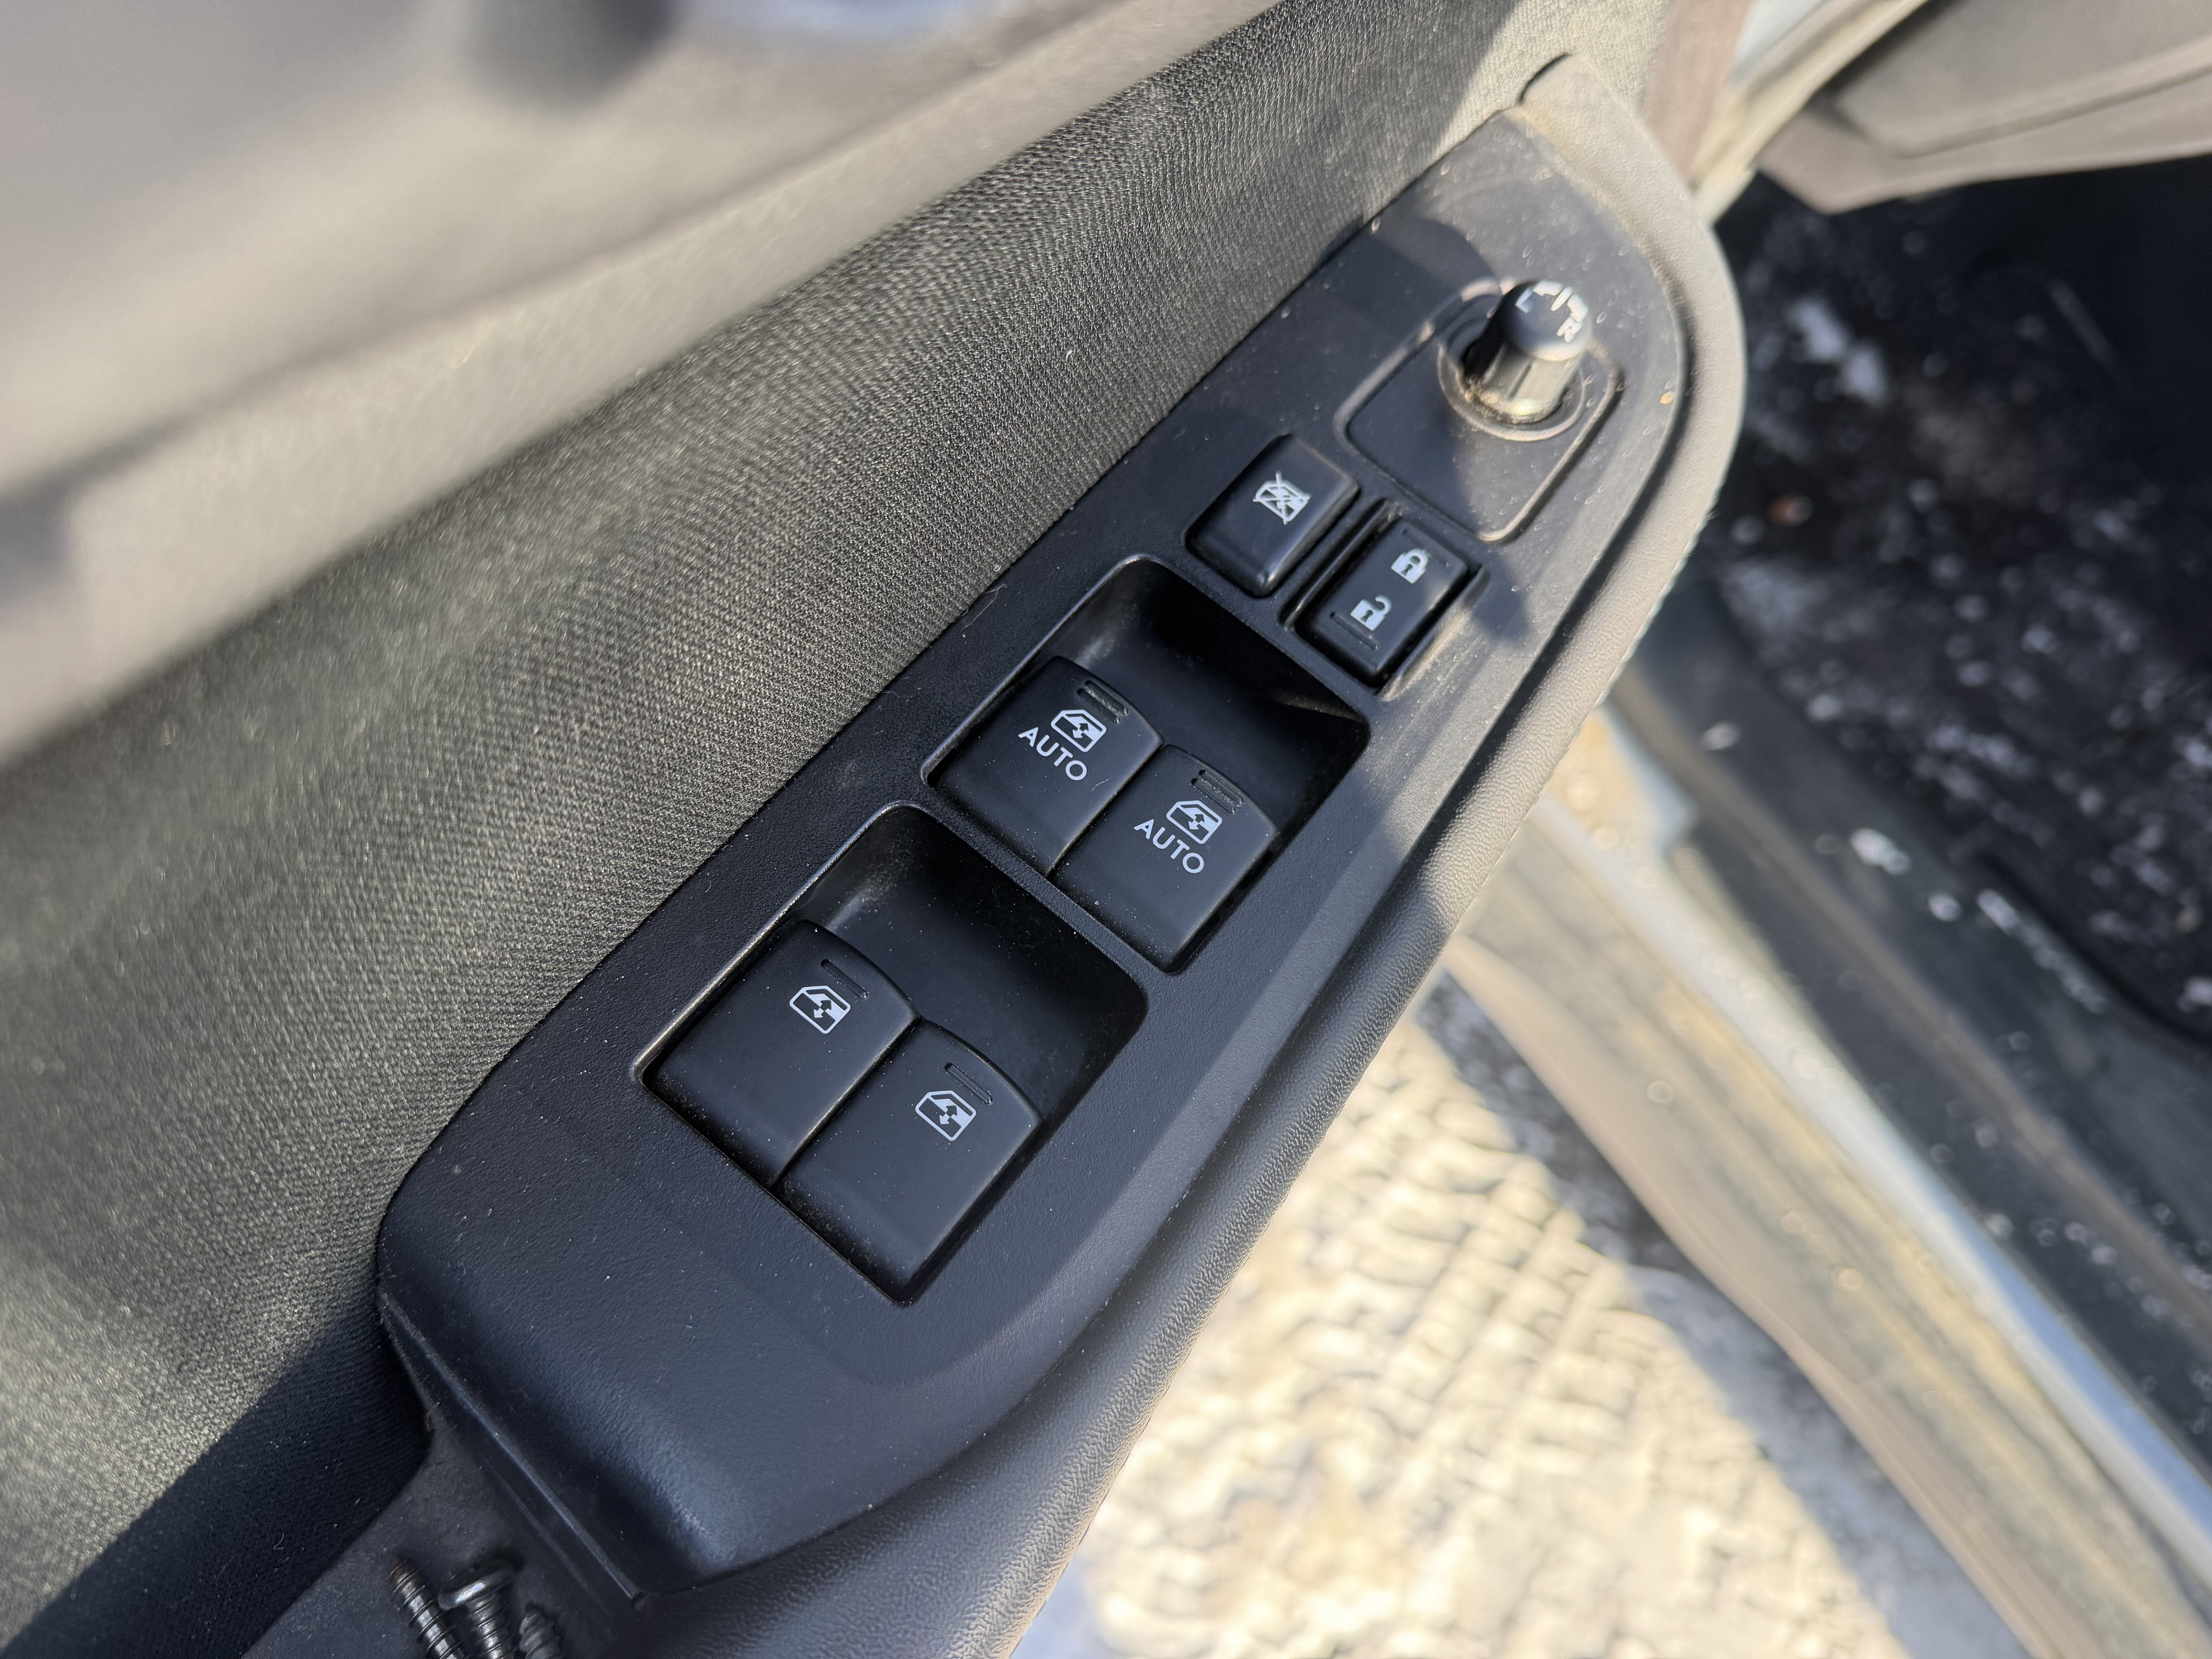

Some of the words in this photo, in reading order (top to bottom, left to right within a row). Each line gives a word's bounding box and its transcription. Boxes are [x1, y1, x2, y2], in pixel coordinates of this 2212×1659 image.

[1556, 316, 1584, 343] R
[1018, 727, 1087, 780] AUTO
[1134, 819, 1204, 873] AUTO
